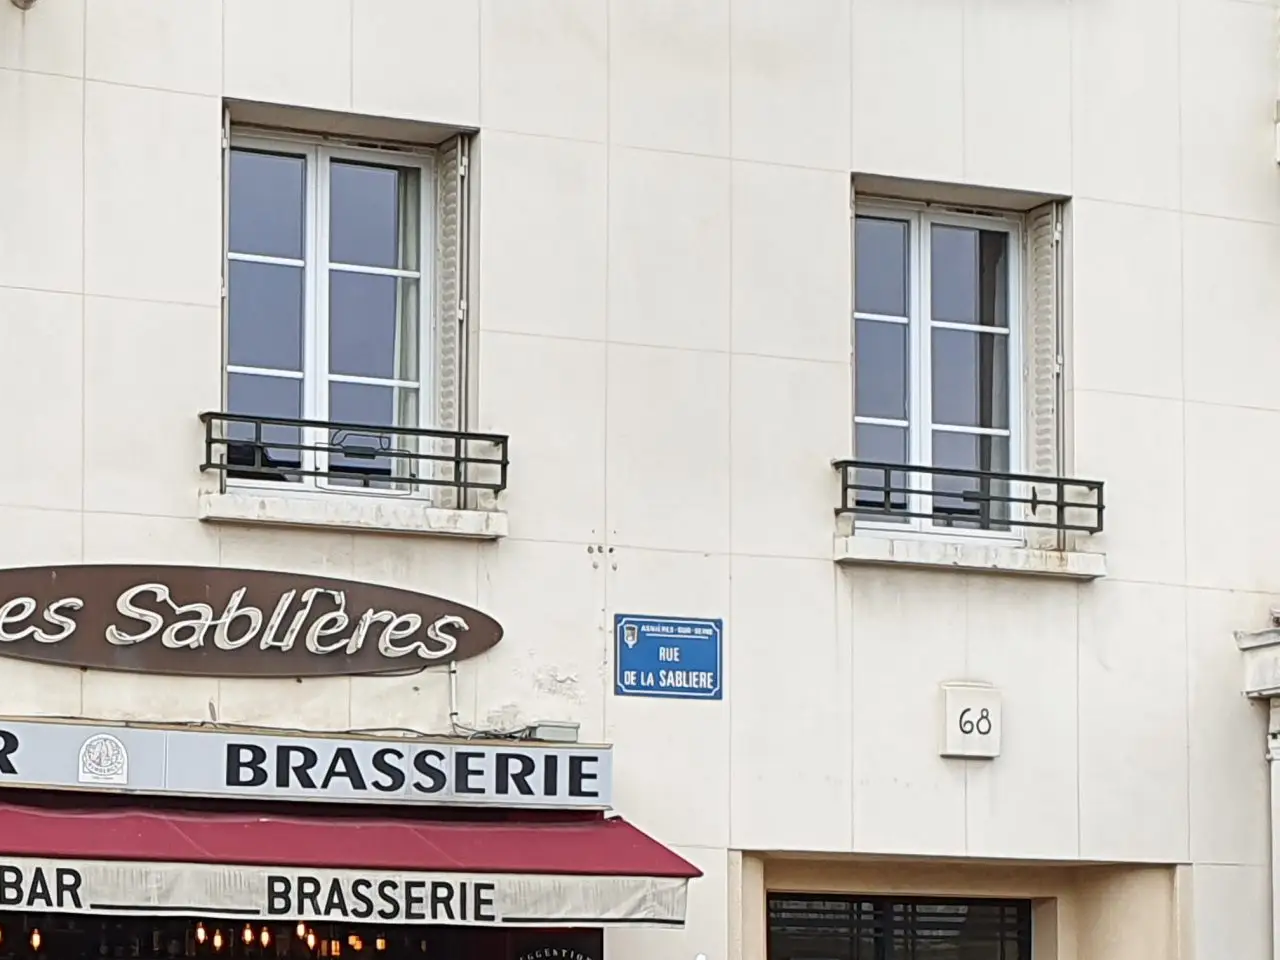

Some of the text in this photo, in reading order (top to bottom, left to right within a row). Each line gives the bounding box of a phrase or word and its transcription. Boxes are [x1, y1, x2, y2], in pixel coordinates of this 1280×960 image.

[106, 583, 469, 660] Sablières
[659, 647, 680, 662] RUE
[624, 671, 637, 685] DE
[641, 672, 654, 686] LA
[959, 708, 991, 735] 68
[226, 744, 598, 797] BRASSERIE
[267, 876, 496, 921] BRASSERIE
